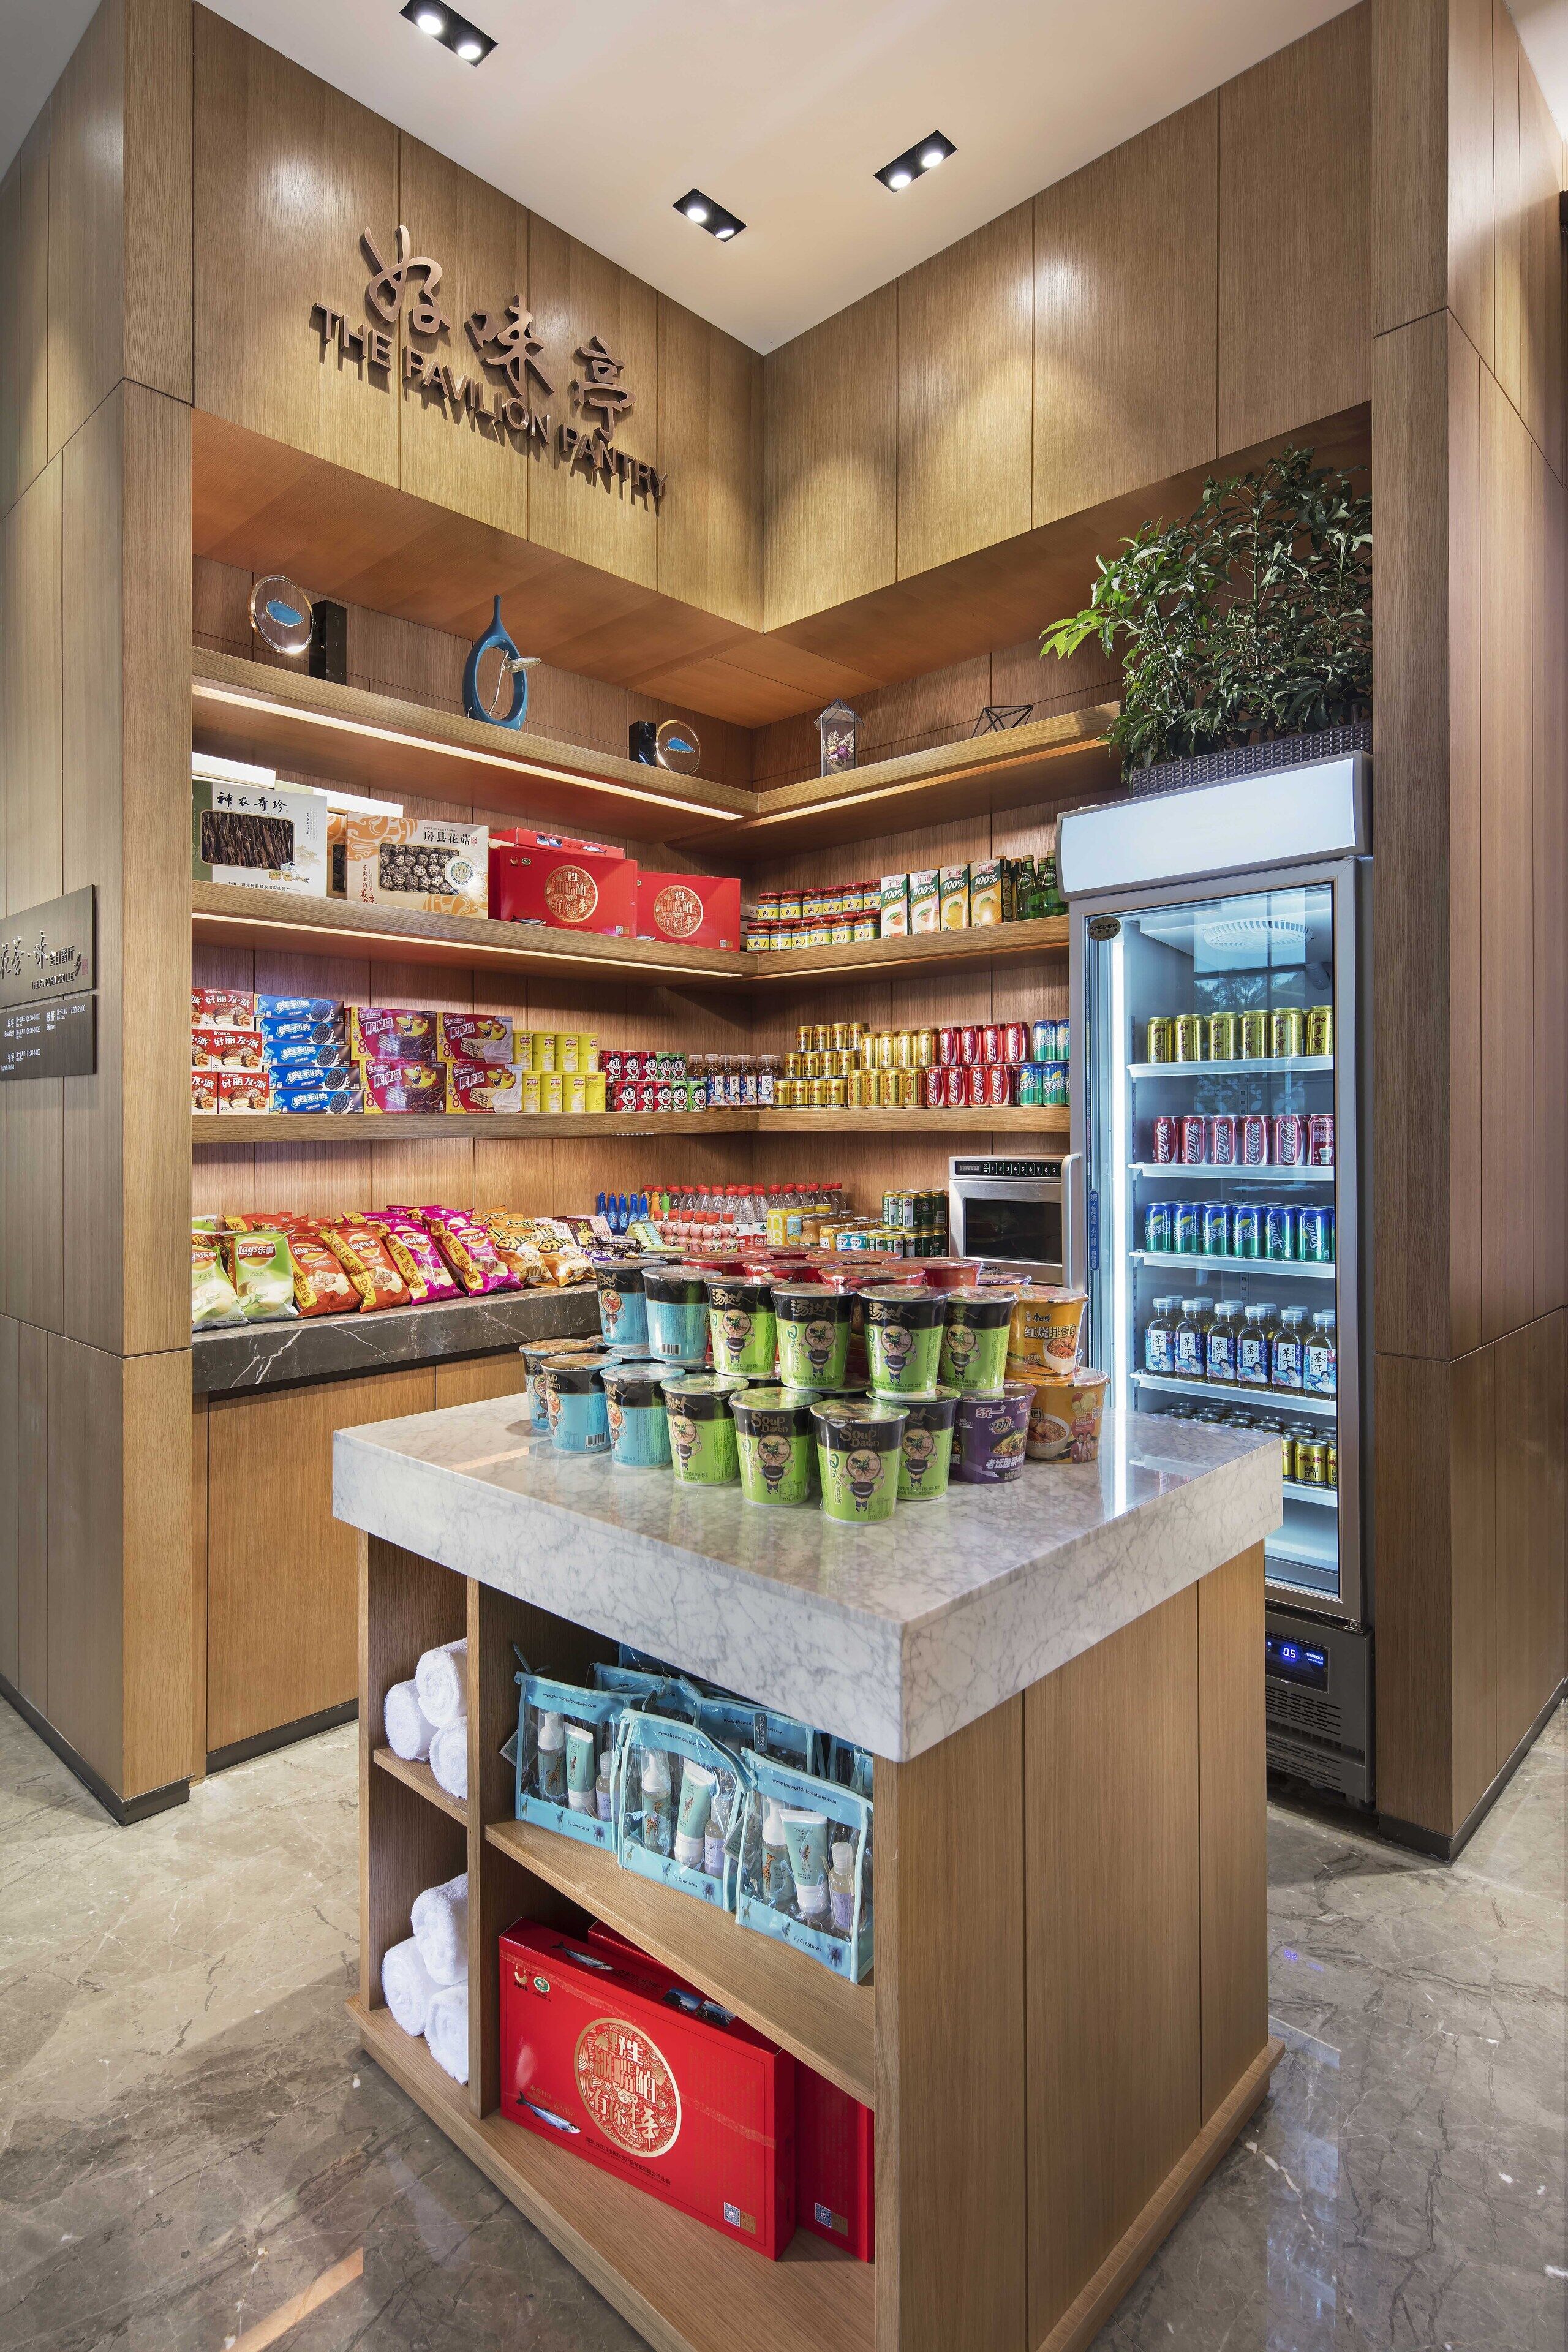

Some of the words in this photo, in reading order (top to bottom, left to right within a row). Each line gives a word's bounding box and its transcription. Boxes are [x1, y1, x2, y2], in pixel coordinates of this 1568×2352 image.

[312, 301, 393, 371] THE
[402, 346, 550, 446] PAVILION
[559, 423, 668, 499] PANTRY
[216, 792, 288, 813] 神农奇珍
[424, 831, 470, 845] 房县花菇
[943, 878, 965, 889] 100%
[974, 874, 997, 885] 100%
[884, 888, 903, 899] 100%
[913, 884, 935, 896] 100%
[205, 995, 251, 1008] 好丽友·派
[275, 1000, 310, 1013] 奥利奥
[47, 1011, 55, 1022] 晚餐
[69, 1005, 86, 1014] 17:30-21:00
[7, 1019, 14, 1028] 早餐
[239, 1016, 250, 1025] 仁
[366, 1017, 394, 1035] 脆脆鲨
[276, 1023, 312, 1038] 奥利奥
[450, 1022, 475, 1039] 脆脆鲨
[214, 1035, 259, 1049] 好丽友·派
[358, 1039, 366, 1054] 8
[443, 1042, 451, 1057] 8
[7, 1053, 14, 1063] 午餐
[281, 1045, 316, 1060] 奥利奥
[197, 1056, 208, 1065] 仁
[247, 1057, 258, 1065] 仁
[221, 1076, 266, 1090] 好丽友·派
[286, 1068, 324, 1084] 奥利奥
[374, 1068, 402, 1088] 脆脆鲨
[459, 1071, 484, 1090] 脆脆鲨
[255, 1098, 266, 1107] 仁
[292, 1092, 328, 1107] 奥利奥
[366, 1092, 375, 1107] 8
[452, 1093, 460, 1107] 8
[1156, 1123, 1169, 1162] 可口可乐
[1188, 1123, 1200, 1162] 可口可乐
[1218, 1123, 1231, 1162] 可口可乐
[1145, 1221, 1170, 1238] 雪碧
[1174, 1222, 1199, 1239] 雪碧
[1204, 1222, 1231, 1241] 雪碧
[1233, 1223, 1259, 1242] 雪碧
[1272, 1221, 1283, 1248] Sprite
[1309, 1223, 1321, 1250] Sprite
[712, 1289, 755, 1307] 汤达人
[791, 1299, 838, 1317] 汤达人
[868, 1302, 916, 1322] 汤达人
[1024, 1324, 1076, 1339] 红烧排骨面
[1155, 1334, 1164, 1352] 茶π
[1183, 1337, 1193, 1355] 茶π
[1216, 1341, 1225, 1359] 茶π
[1246, 1344, 1256, 1363] 茶π
[1282, 1348, 1292, 1366] 茶π
[751, 1411, 786, 1429] Soup
[976, 1407, 1005, 1419] 统一
[840, 1425, 877, 1443] Soup
[1305, 1652, 1323, 1660] KINGDO
[543, 1692, 597, 1709] www.theworldofcreatures.com
[772, 1778, 837, 1804] www.theworldofcreatures.com
[572, 1822, 590, 1832] Creatures
[678, 1877, 698, 1888] Creatures
[799, 1939, 822, 1952] Creatures
[609, 2030, 644, 2065] 野生
